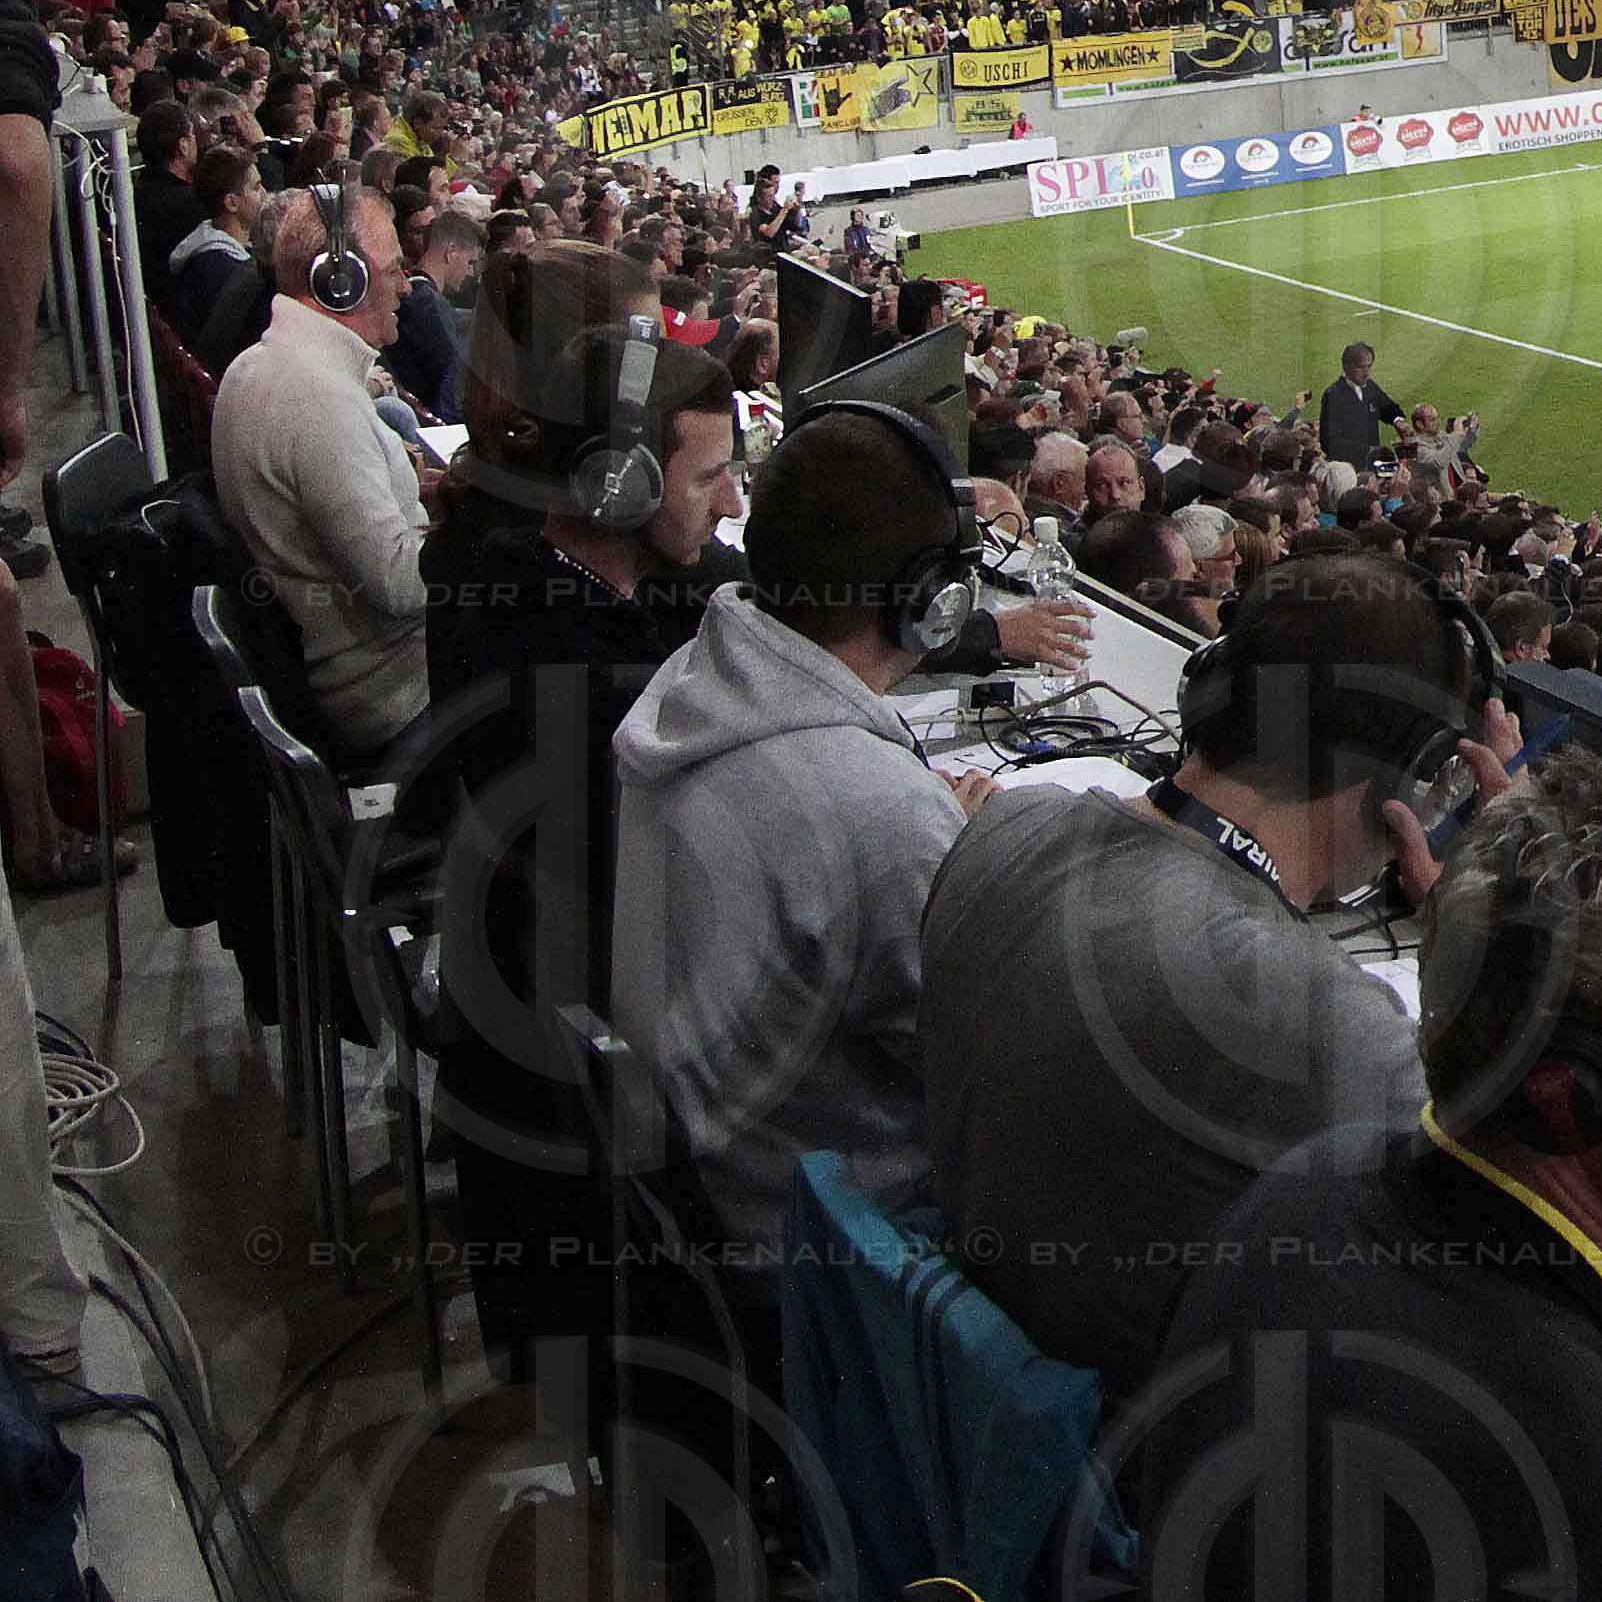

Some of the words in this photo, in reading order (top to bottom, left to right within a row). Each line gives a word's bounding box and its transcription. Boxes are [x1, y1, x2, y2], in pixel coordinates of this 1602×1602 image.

[984, 61, 1028, 83] USCHI
[1498, 136, 1551, 152] EROTISCH
[1554, 129, 1602, 144] SHOPPEN
[1035, 157, 1110, 203] SPI
[1039, 202, 1070, 213] SPORT
[1072, 200, 1093, 210] FOR
[1094, 197, 1119, 208] YOUR
